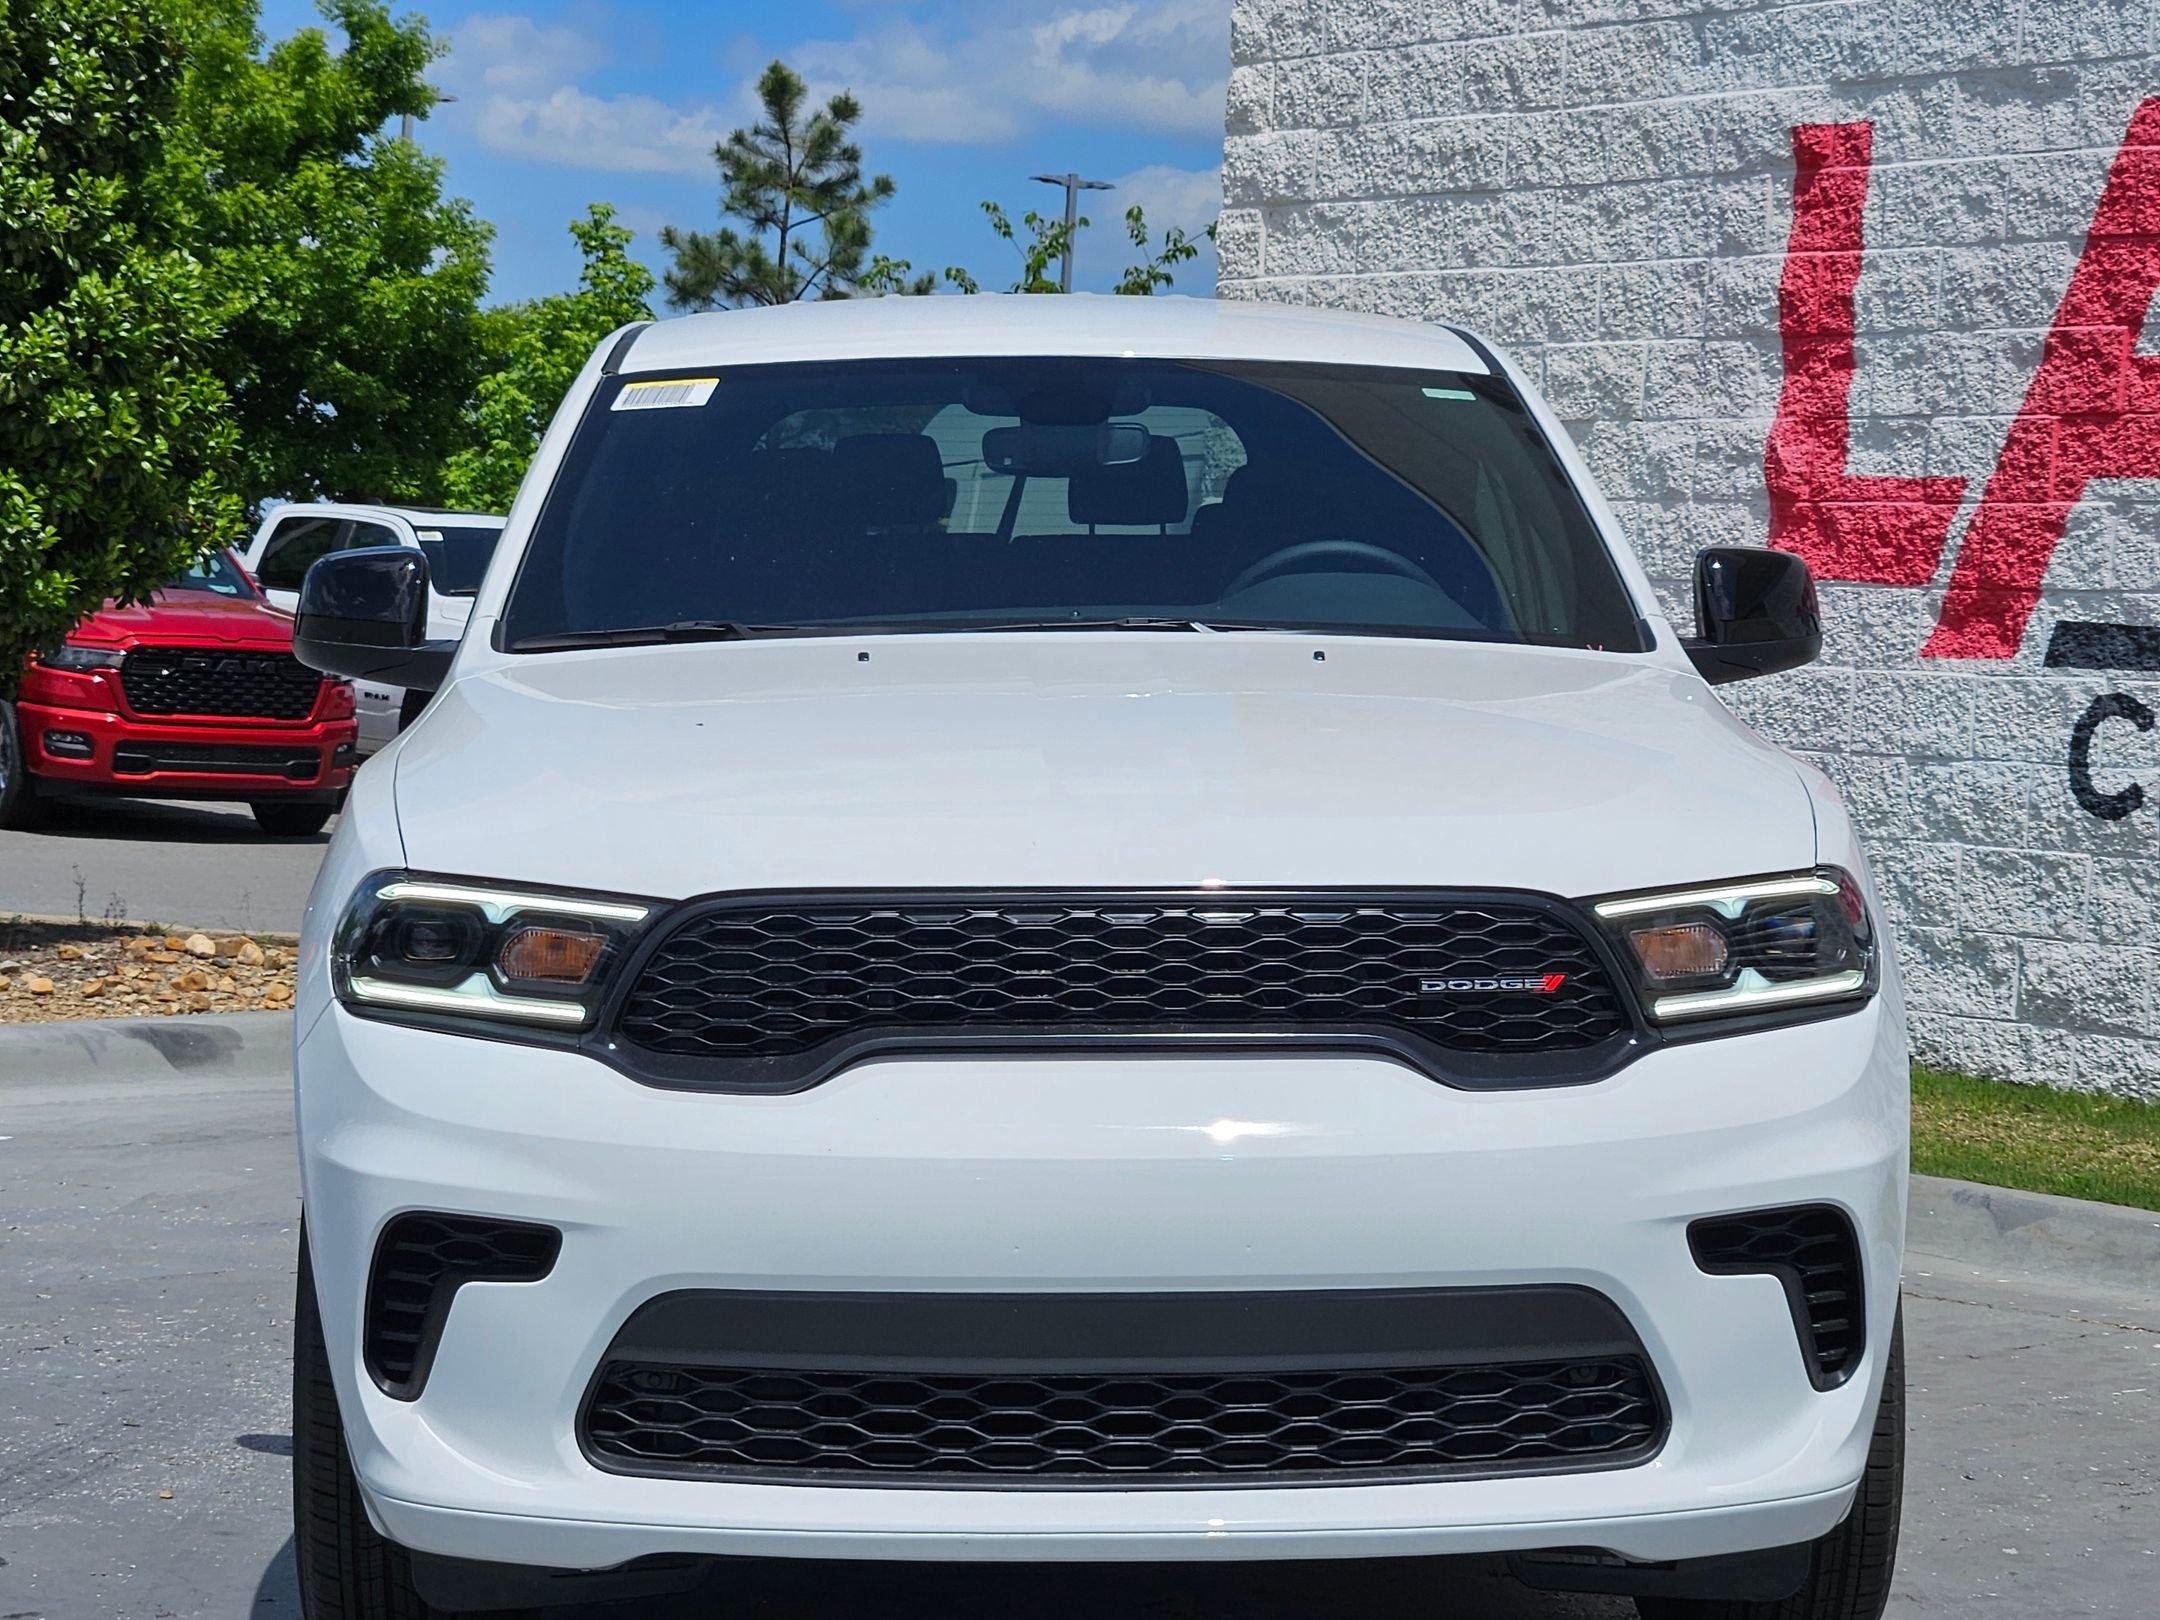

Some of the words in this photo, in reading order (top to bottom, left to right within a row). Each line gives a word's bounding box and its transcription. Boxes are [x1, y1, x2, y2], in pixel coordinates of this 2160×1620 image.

[182, 656, 277, 674] RAM
[364, 691, 390, 701] RAM
[1421, 979, 1548, 992] DODGE
